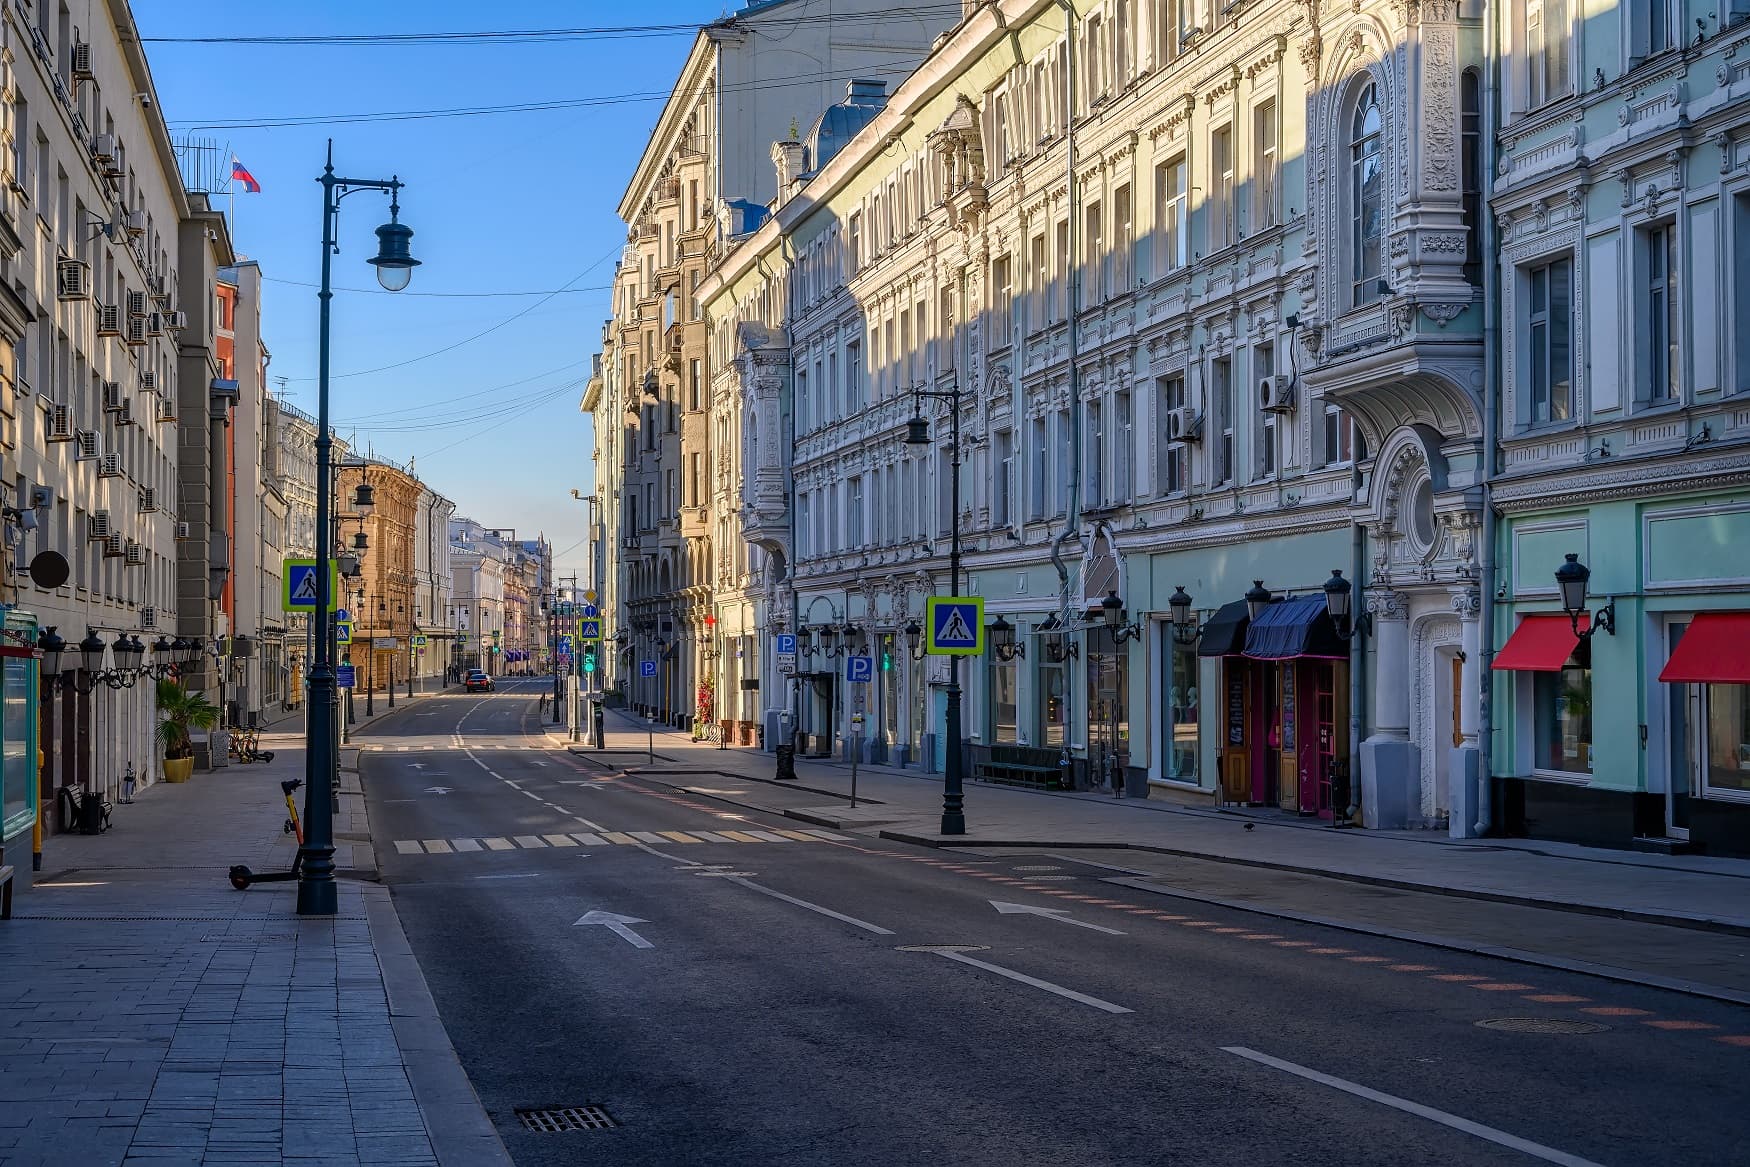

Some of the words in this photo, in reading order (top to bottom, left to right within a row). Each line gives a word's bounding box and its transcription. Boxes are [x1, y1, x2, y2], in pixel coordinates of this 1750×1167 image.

[783, 636, 792, 651] P
[645, 663, 654, 675] P
[852, 658, 868, 680] P
